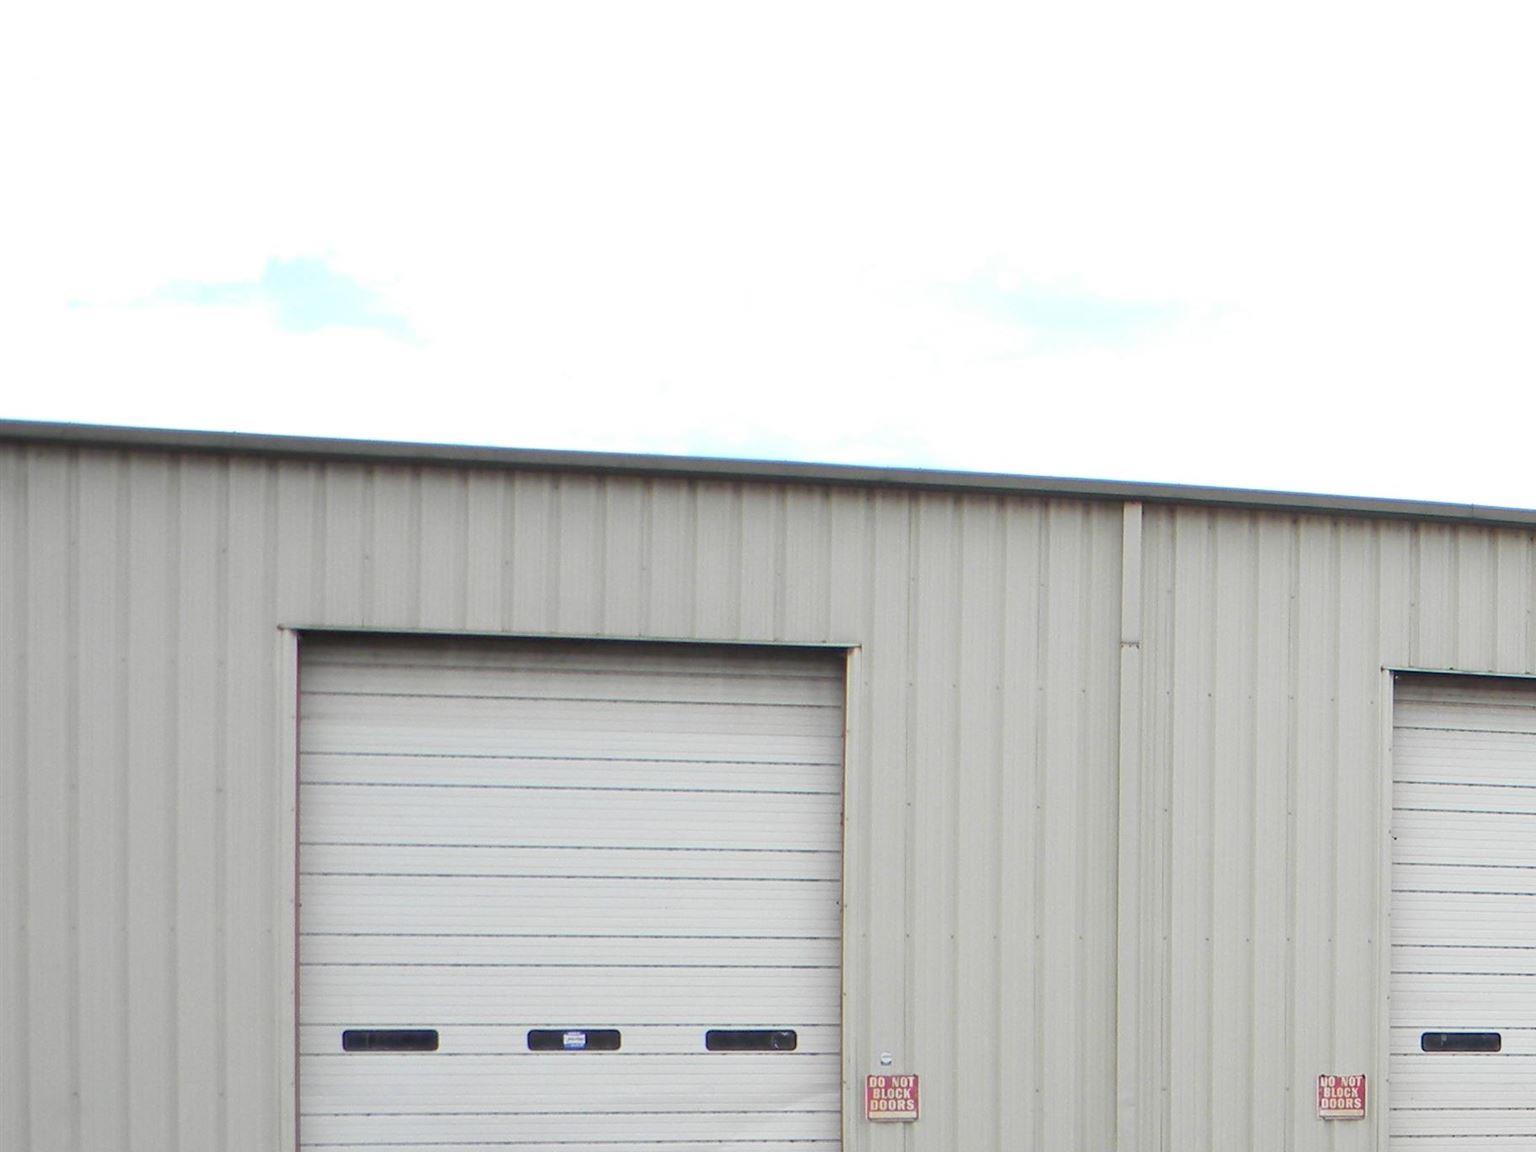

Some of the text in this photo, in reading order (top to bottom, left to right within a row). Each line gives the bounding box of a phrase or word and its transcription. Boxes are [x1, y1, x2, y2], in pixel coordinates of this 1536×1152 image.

[869, 1076, 915, 1088] DO NOT
[1320, 1076, 1363, 1088] DO NOT
[872, 1087, 912, 1099] BLOCK
[1323, 1087, 1359, 1098] BLOCK
[870, 1099, 915, 1111] DOORS
[1321, 1098, 1362, 1109] DOORS
